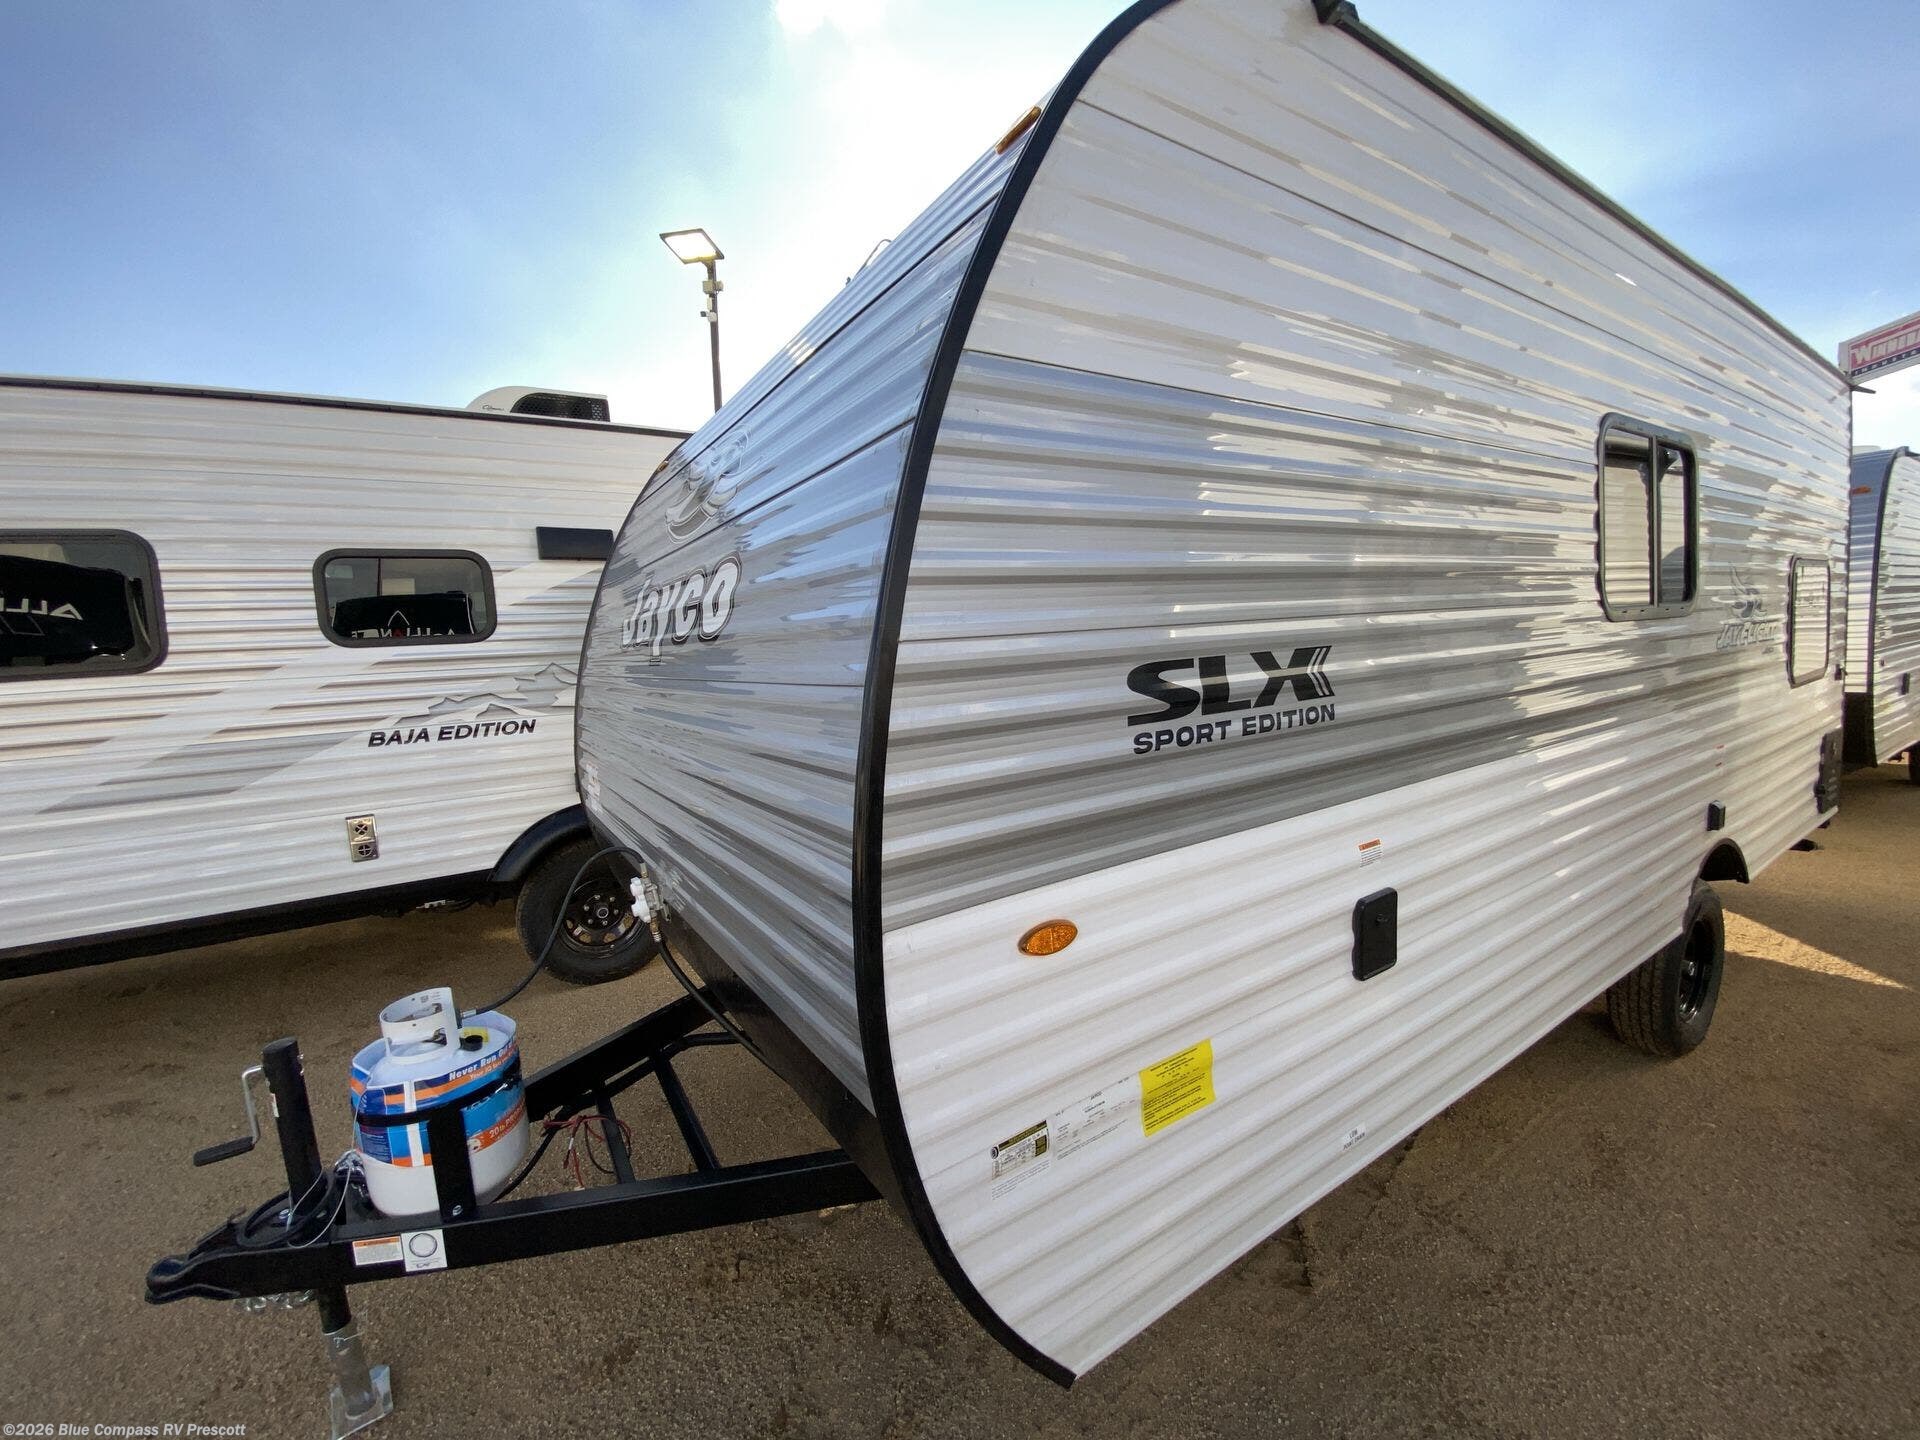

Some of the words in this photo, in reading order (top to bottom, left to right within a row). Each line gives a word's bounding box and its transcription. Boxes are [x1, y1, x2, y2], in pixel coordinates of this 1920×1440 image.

[1127, 645, 1335, 727] SLX
[368, 727, 430, 748] BAJA
[437, 719, 537, 742] EDITION
[1133, 720, 1232, 755] SPORT
[1241, 704, 1336, 737] EDITION
[449, 1064, 478, 1081] Never
[480, 1054, 497, 1067] Run
